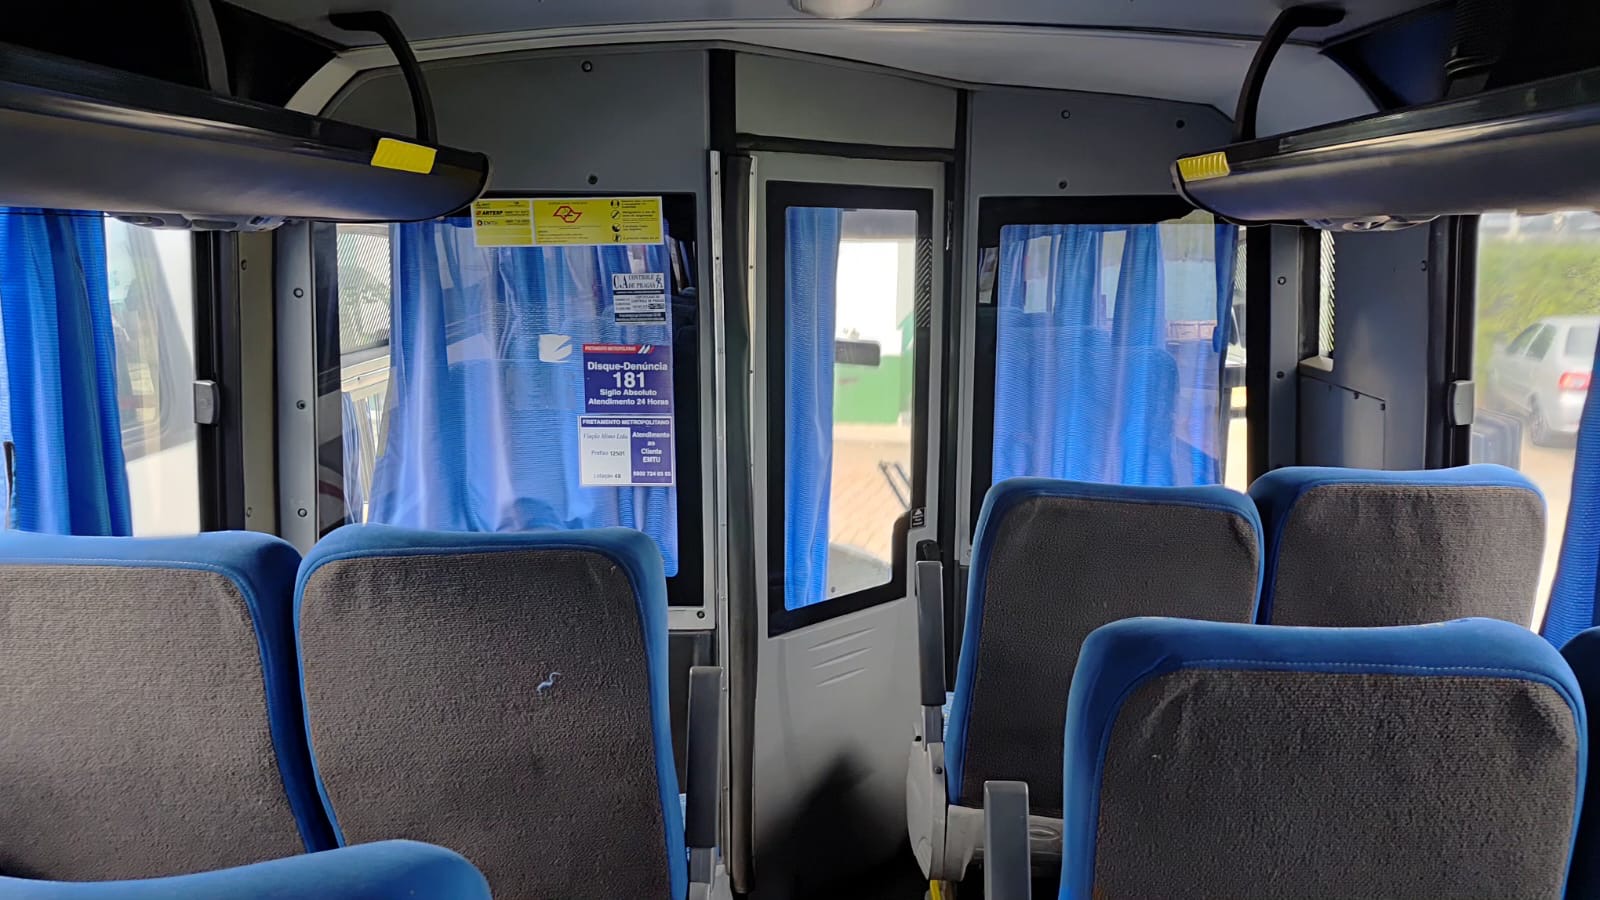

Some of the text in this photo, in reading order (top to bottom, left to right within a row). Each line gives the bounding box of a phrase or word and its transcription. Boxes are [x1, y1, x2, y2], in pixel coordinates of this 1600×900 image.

[587, 361, 668, 372] Disque-Denúncia
[613, 371, 645, 388] 181
[623, 388, 657, 396] Absoluto
